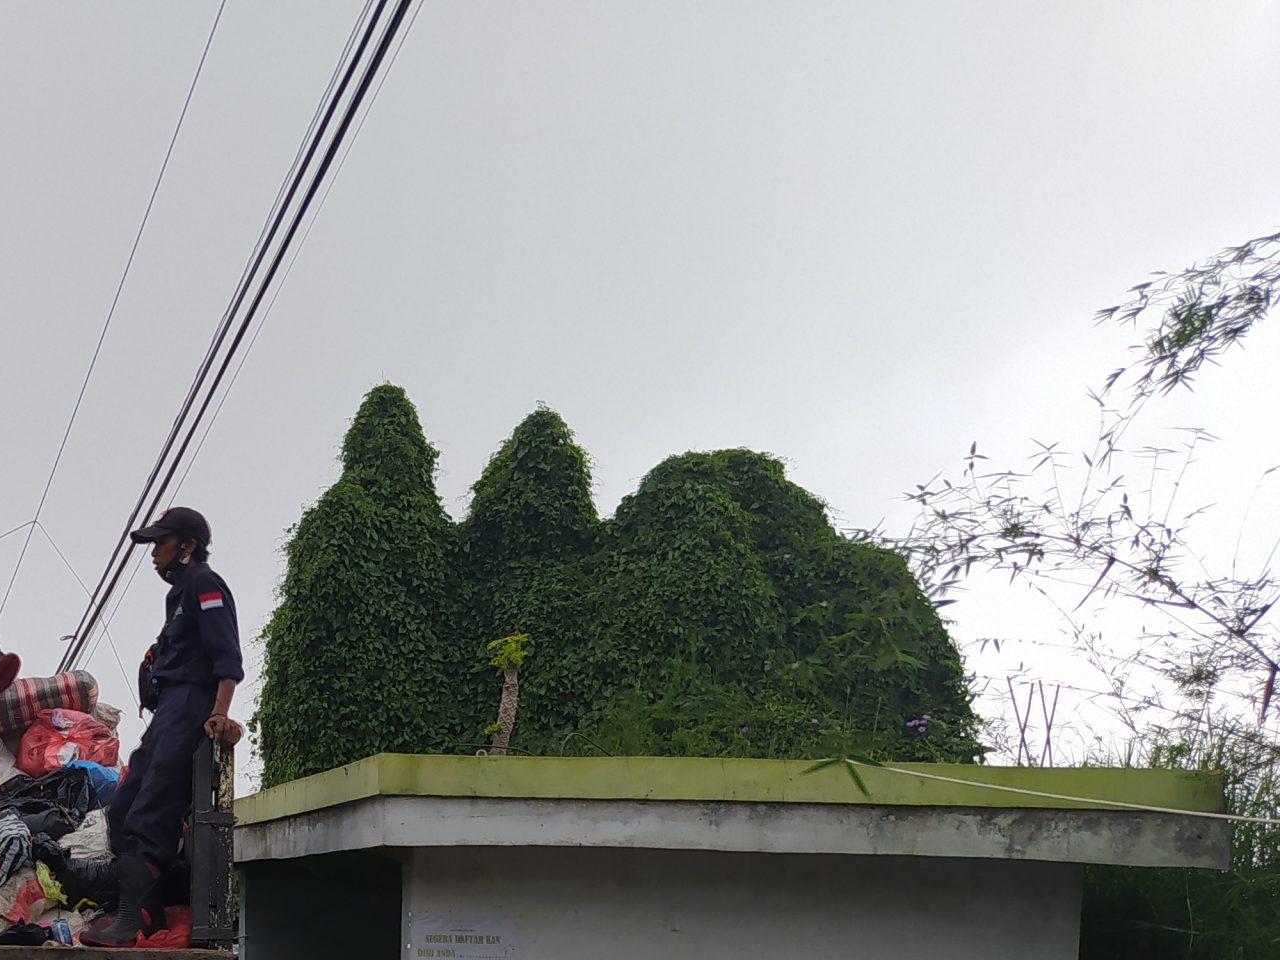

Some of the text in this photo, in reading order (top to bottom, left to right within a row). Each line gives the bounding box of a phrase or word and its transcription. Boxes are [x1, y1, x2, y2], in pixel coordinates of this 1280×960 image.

[425, 934, 453, 944] SEGERA
[455, 935, 484, 944] DAFTAR
[436, 949, 456, 958] ANDA
